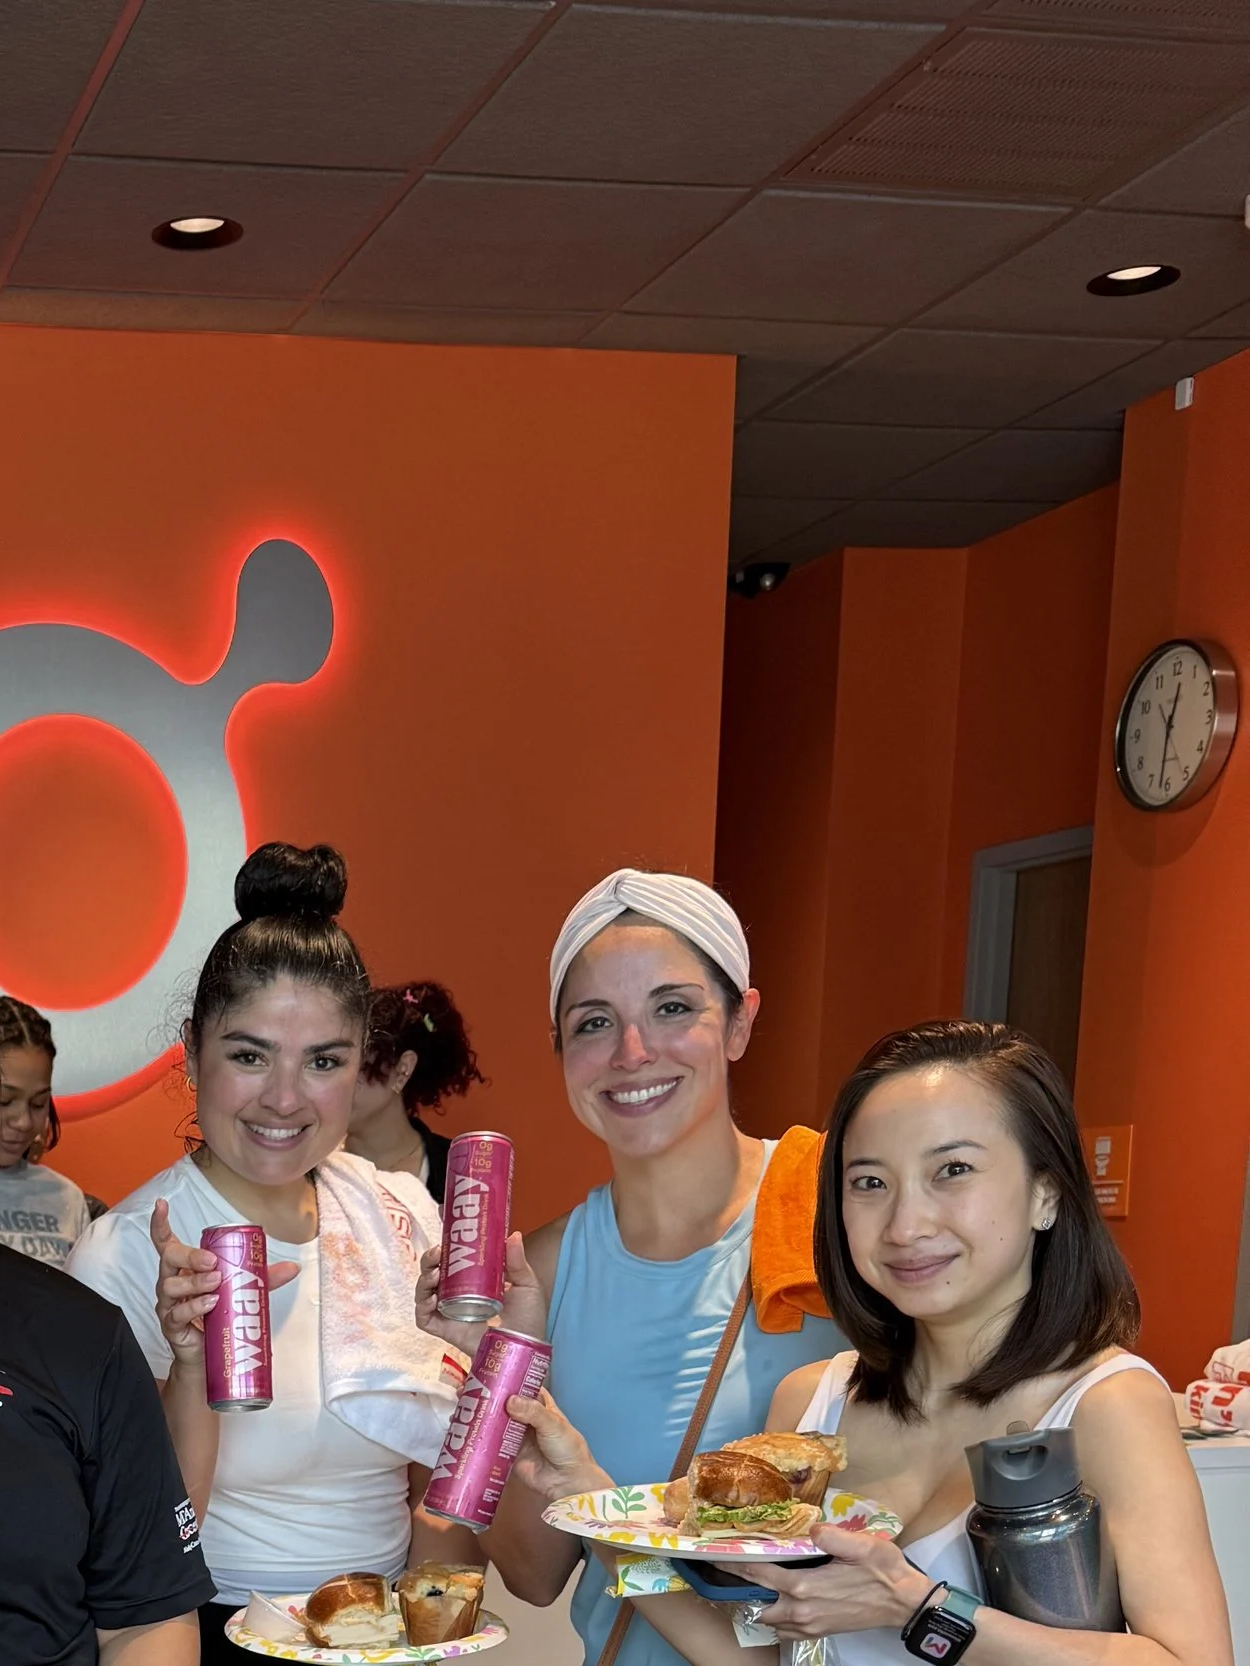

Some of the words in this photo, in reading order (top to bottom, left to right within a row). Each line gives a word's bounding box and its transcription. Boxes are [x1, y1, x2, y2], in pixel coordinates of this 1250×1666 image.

[1173, 661, 1183, 676] 12
[1193, 665, 1197, 679] 1
[1156, 675, 1164, 690] 11
[1203, 682, 1210, 696] 2
[1141, 701, 1151, 715] 10
[1206, 710, 1213, 725] 3
[1134, 728, 1141, 743] 9
[1197, 740, 1204, 753] 4
[1137, 756, 1144, 769] 8
[1149, 774, 1155, 786] 7
[1183, 766, 1190, 780] 5
[1165, 777, 1171, 792] 6
[474, 1158, 492, 1168] 10g
[448, 1175, 490, 1277] waay
[232, 1266, 264, 1376] waay
[224, 1327, 233, 1378] Grapefruit
[494, 1341, 508, 1353] 0g
[485, 1358, 501, 1373] 10g
[455, 1444, 473, 1480] Sparkling
